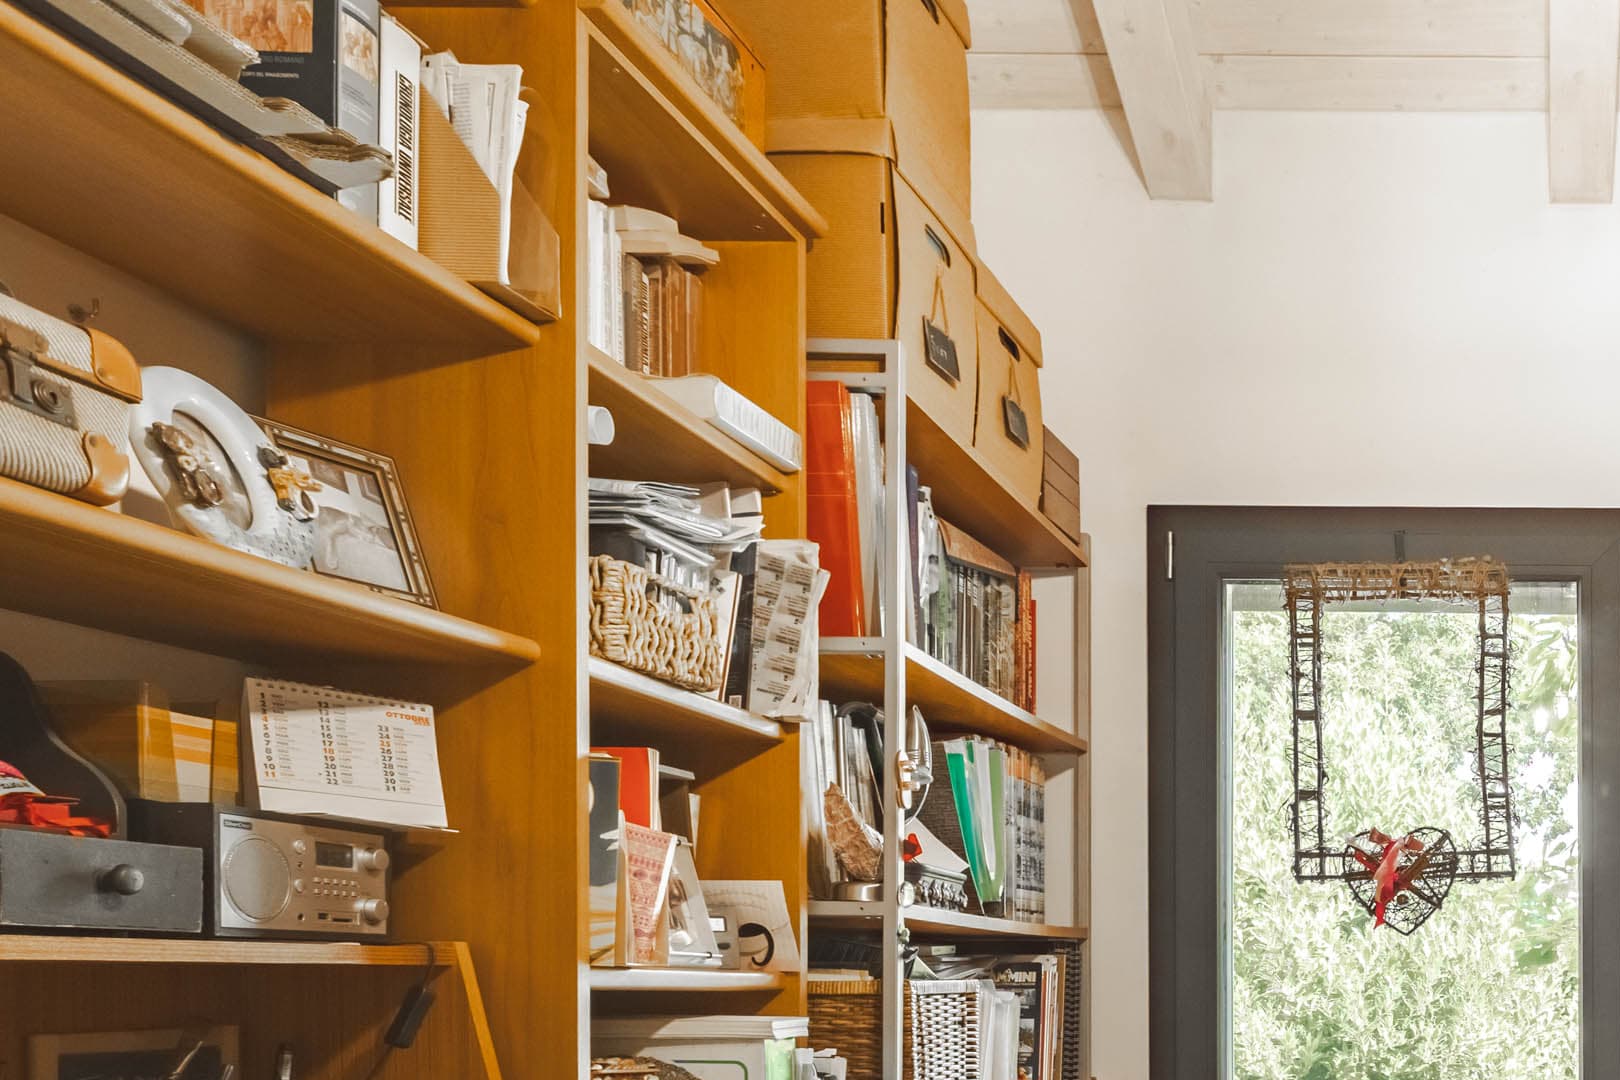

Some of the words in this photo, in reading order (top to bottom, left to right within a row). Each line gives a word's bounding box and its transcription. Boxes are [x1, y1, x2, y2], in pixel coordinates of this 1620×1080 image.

[399, 73, 413, 152] CRONOLOGIA
[398, 152, 412, 223] UNIVERSALE
[385, 711, 430, 723] OTTOBRE
[379, 740, 391, 748] 25
[380, 747, 392, 755] 26
